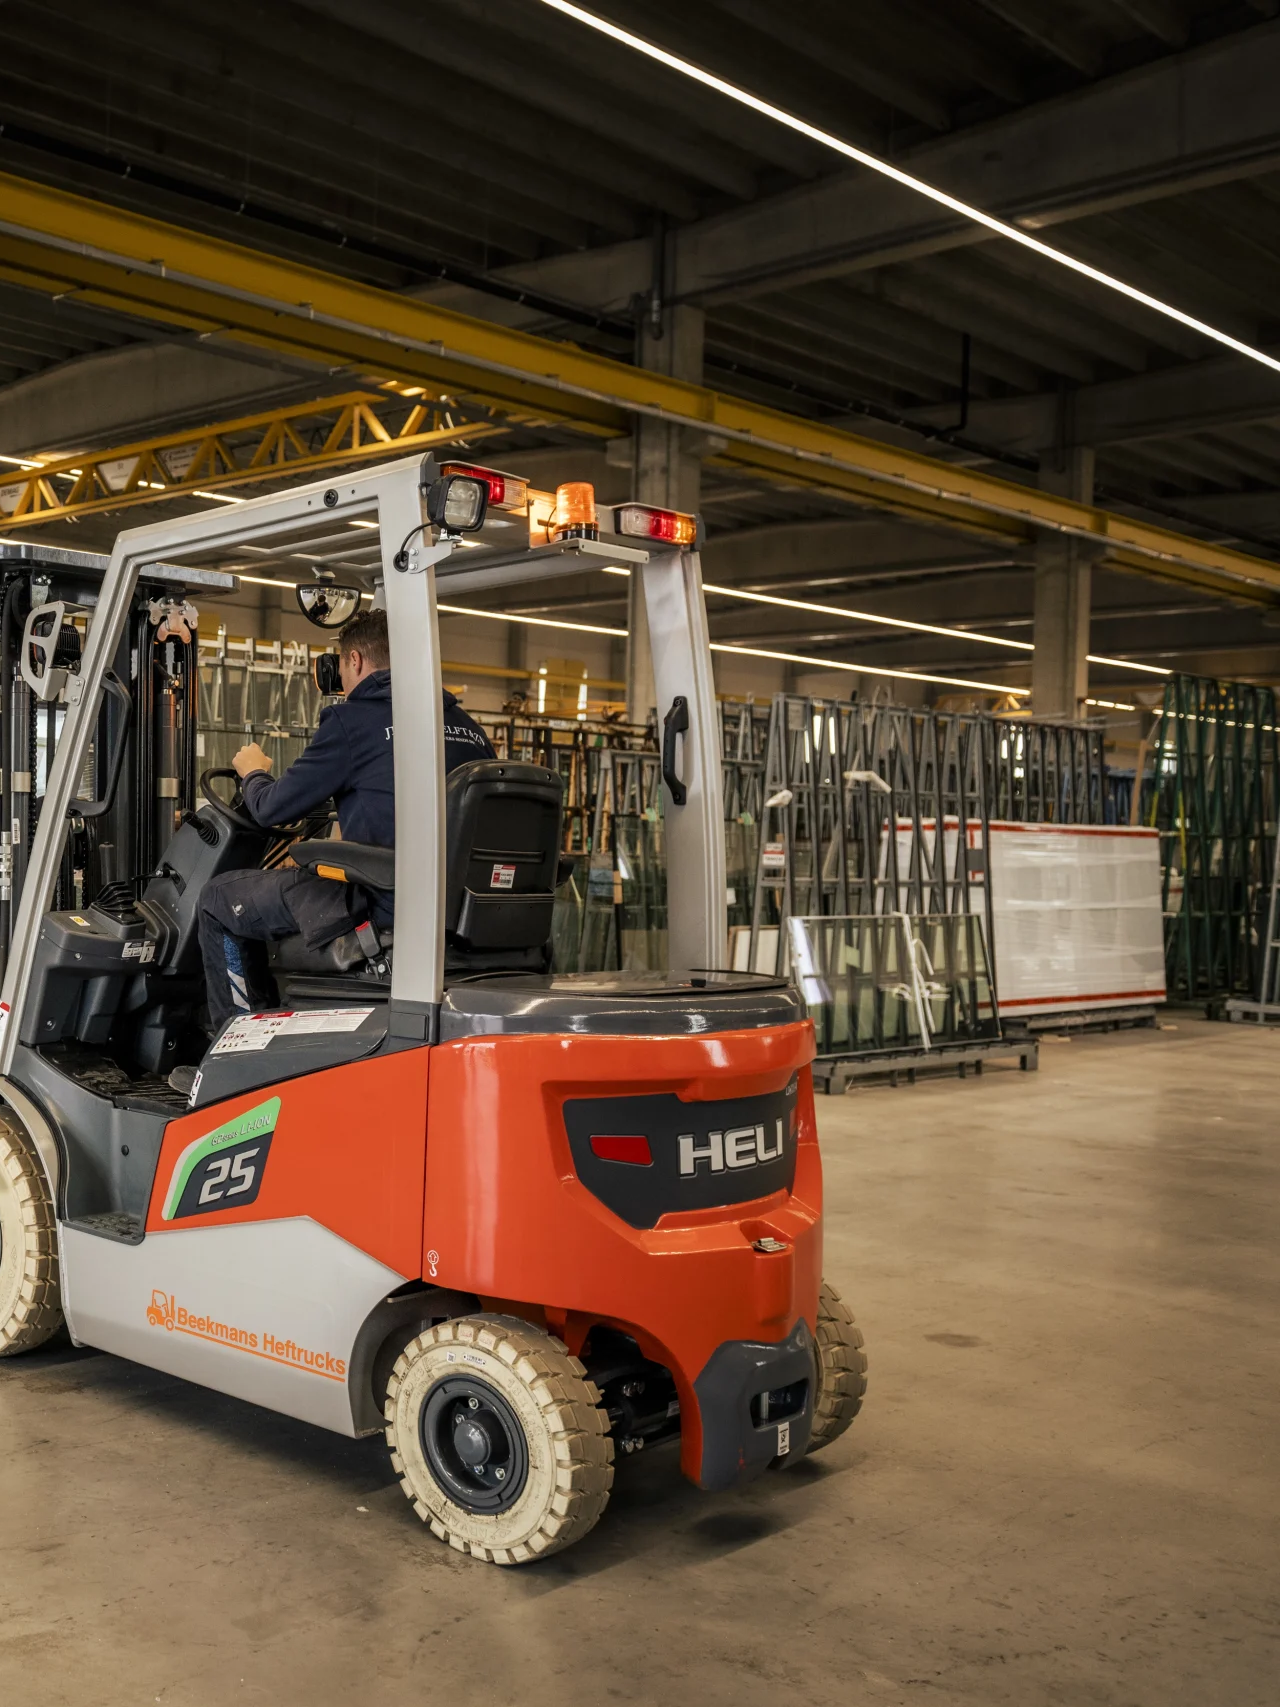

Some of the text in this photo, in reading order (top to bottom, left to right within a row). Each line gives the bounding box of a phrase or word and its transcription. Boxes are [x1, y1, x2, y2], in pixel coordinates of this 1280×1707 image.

[199, 1147, 261, 1206] 25
[678, 1118, 784, 1176] HELI
[177, 1307, 346, 1375] Beekmans Heftrucks
